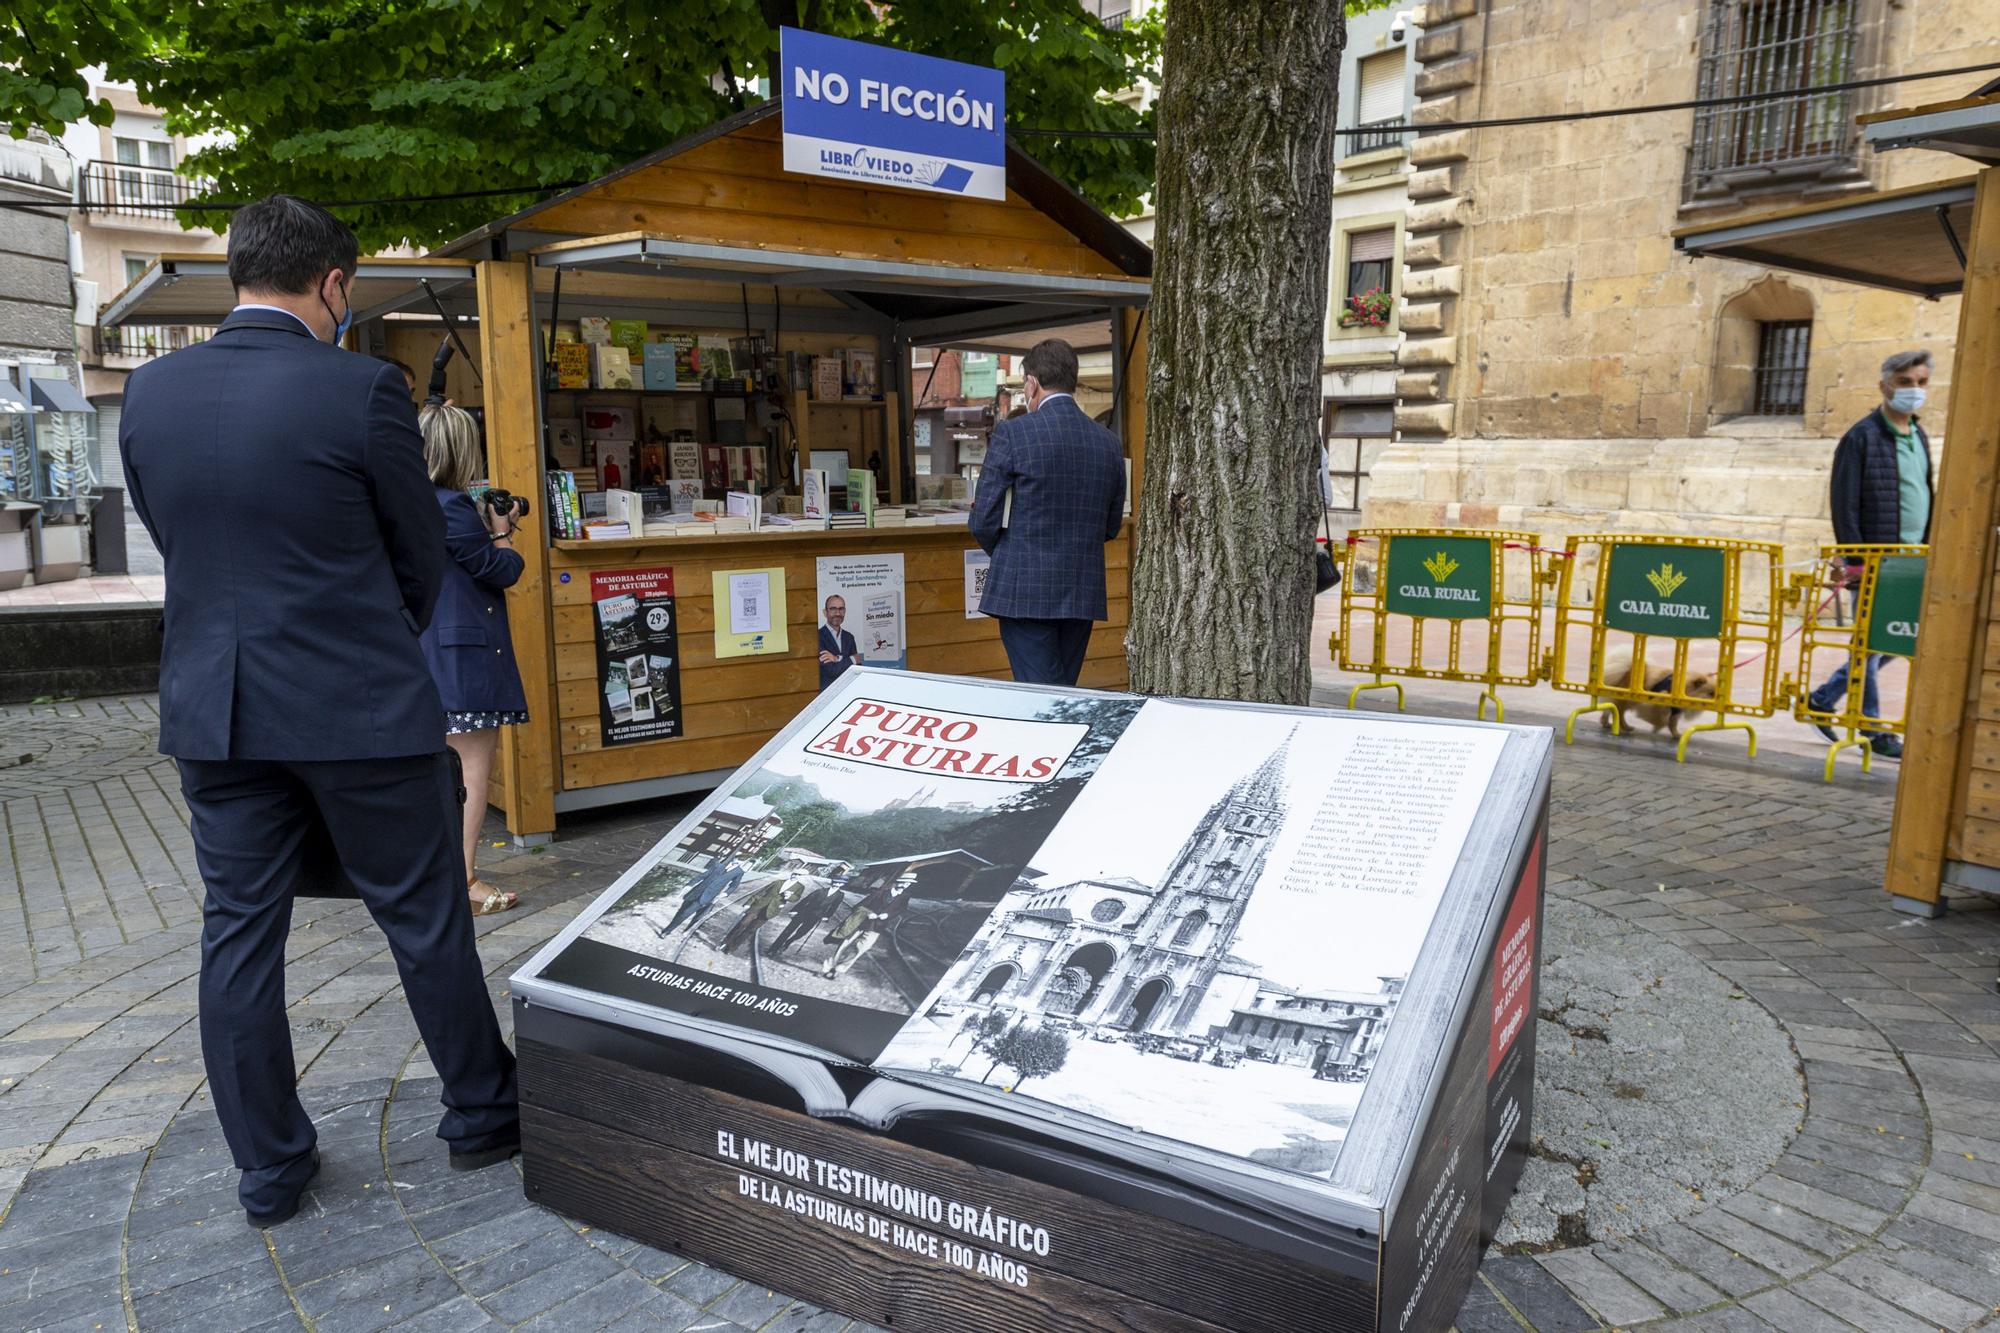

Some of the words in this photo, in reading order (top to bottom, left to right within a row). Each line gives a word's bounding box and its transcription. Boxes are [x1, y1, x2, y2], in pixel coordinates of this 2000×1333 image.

[795, 66, 849, 105] NO
[860, 78, 994, 131] FICCIÓN
[596, 575, 634, 584] MEMORIA
[636, 572, 669, 581] GRÁFICA
[621, 581, 658, 590] ASTURIAS
[1400, 585, 1432, 598] CAJA
[1435, 587, 1480, 602] RURAL
[650, 613, 661, 625] 29
[875, 611, 894, 619] miedo
[1620, 600, 1655, 615] CAJA
[1658, 602, 1710, 620] RURAL
[841, 702, 978, 743] PURO
[813, 728, 1058, 779] ASTURIAS
[1501, 915, 1530, 968] MEMORIA
[626, 964, 694, 990] ASTURIAS
[691, 981, 732, 1001] HACE
[731, 991, 758, 1007] 100
[755, 997, 799, 1017] AÑOS
[1494, 998, 1504, 1025] DE
[1504, 955, 1531, 1010] ASTURIAS
[717, 1130, 739, 1160] EL
[743, 1138, 810, 1184] MEJOR
[814, 1158, 942, 1224] TESTIMONIO
[948, 1203, 1051, 1257] GRÁFICO
[1416, 1207, 1427, 1238] UN
[1426, 1145, 1460, 1218] HOMENAJE
[739, 1175, 758, 1200] DE
[761, 1181, 781, 1208] LA
[784, 1189, 865, 1234] ASTURIAS
[868, 1216, 890, 1243] DE
[893, 1223, 938, 1260] HACE
[942, 1241, 973, 1271] 100
[976, 1251, 1029, 1288] AÑOS
[1417, 1247, 1424, 1268] A
[1424, 1183, 1455, 1255] NUESTROS
[1433, 1242, 1440, 1263] Y
[1439, 1190, 1466, 1255] MAYORES
